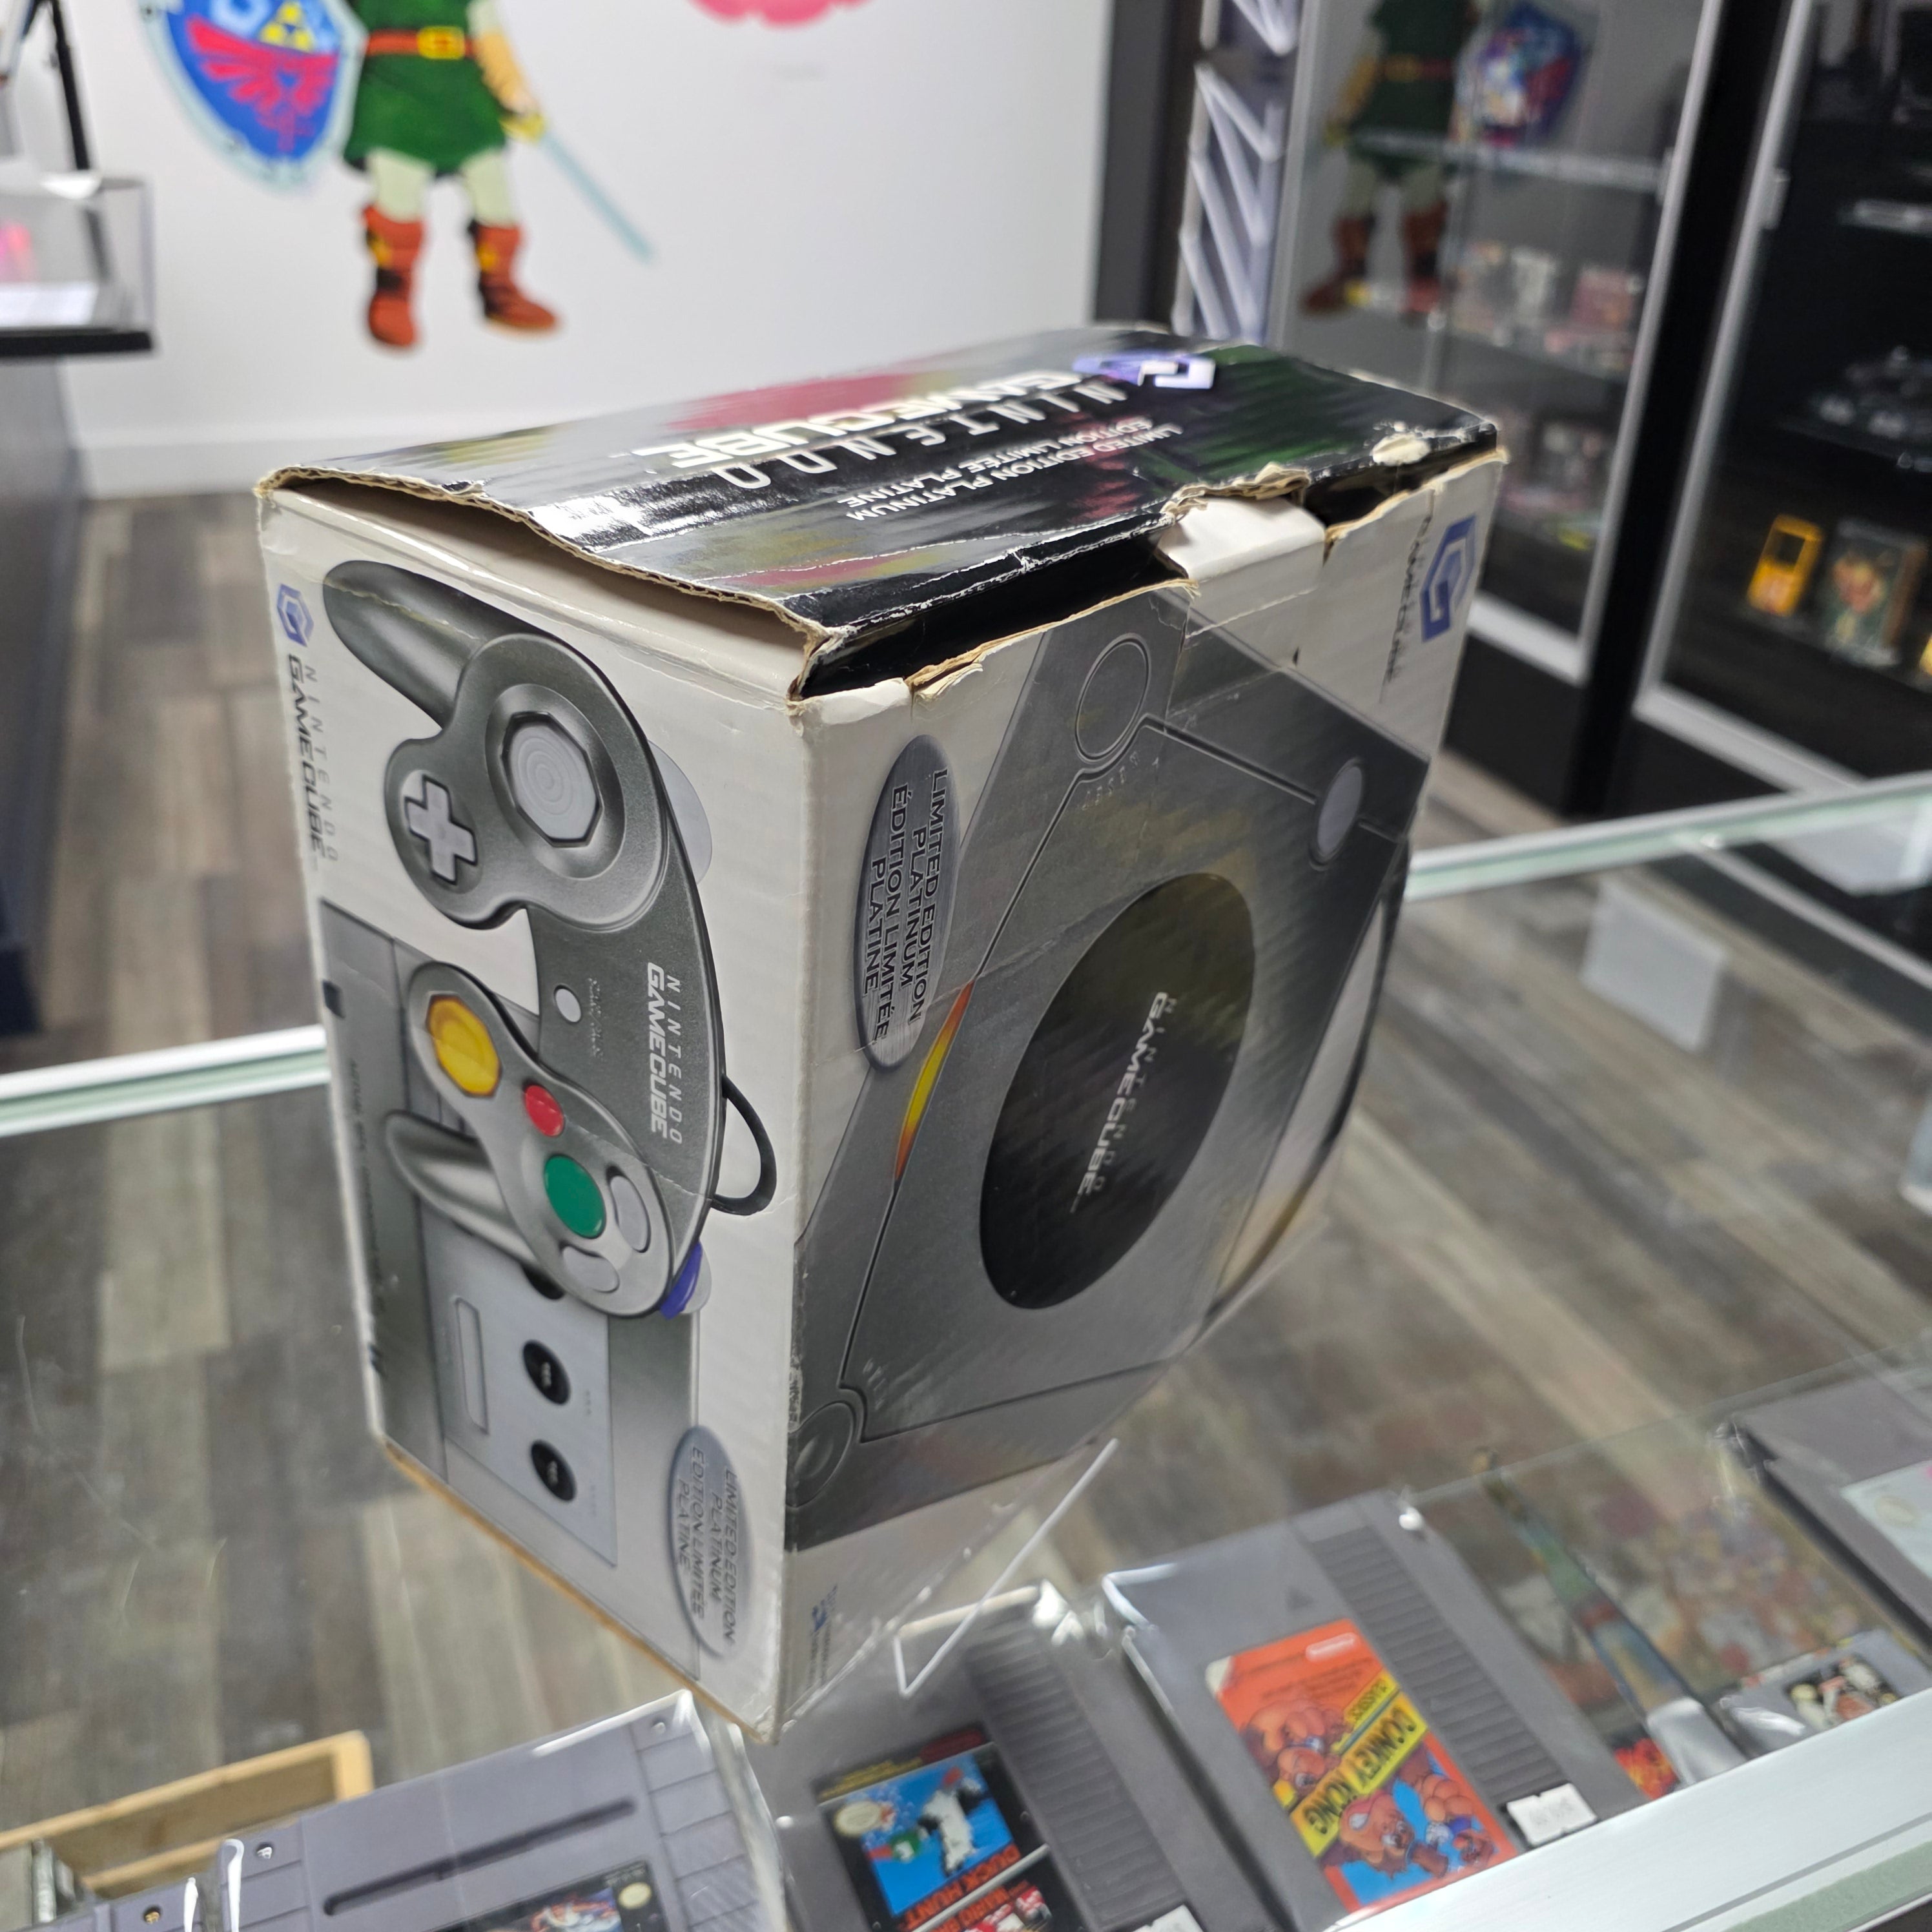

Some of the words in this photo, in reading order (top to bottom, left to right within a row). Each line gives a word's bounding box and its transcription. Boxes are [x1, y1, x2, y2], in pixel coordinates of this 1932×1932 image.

[631, 369, 1083, 468] GAMECUBE
[710, 381, 1127, 489] NINTENDO
[991, 444, 1096, 482] EDITION
[1093, 422, 1183, 452] LIMITED
[838, 466, 963, 508] PLATINE
[845, 475, 993, 521] PLATINUM
[288, 653, 325, 859] GAMECUBE
[304, 664, 338, 862] NINTENDO
[883, 782, 912, 914] ÉDITION
[925, 768, 948, 897] LIMITED
[863, 857, 887, 998] PLATINE
[899, 827, 927, 988] PLATINUM
[908, 903, 936, 1025] EDITION
[873, 924, 899, 1042] LIMITÉE
[647, 962, 668, 1140] GAMECUBE
[667, 975, 683, 1144] NINTENDO
[1077, 992, 1168, 1196] GAMECUBE
[677, 1479, 690, 1571] PLATINE
[710, 1492, 723, 1601] PLATINUM
[724, 1468, 737, 1557] LIMITED
[723, 1557, 737, 1644] EDITION
[1351, 1706, 1418, 1791] DONKEY
